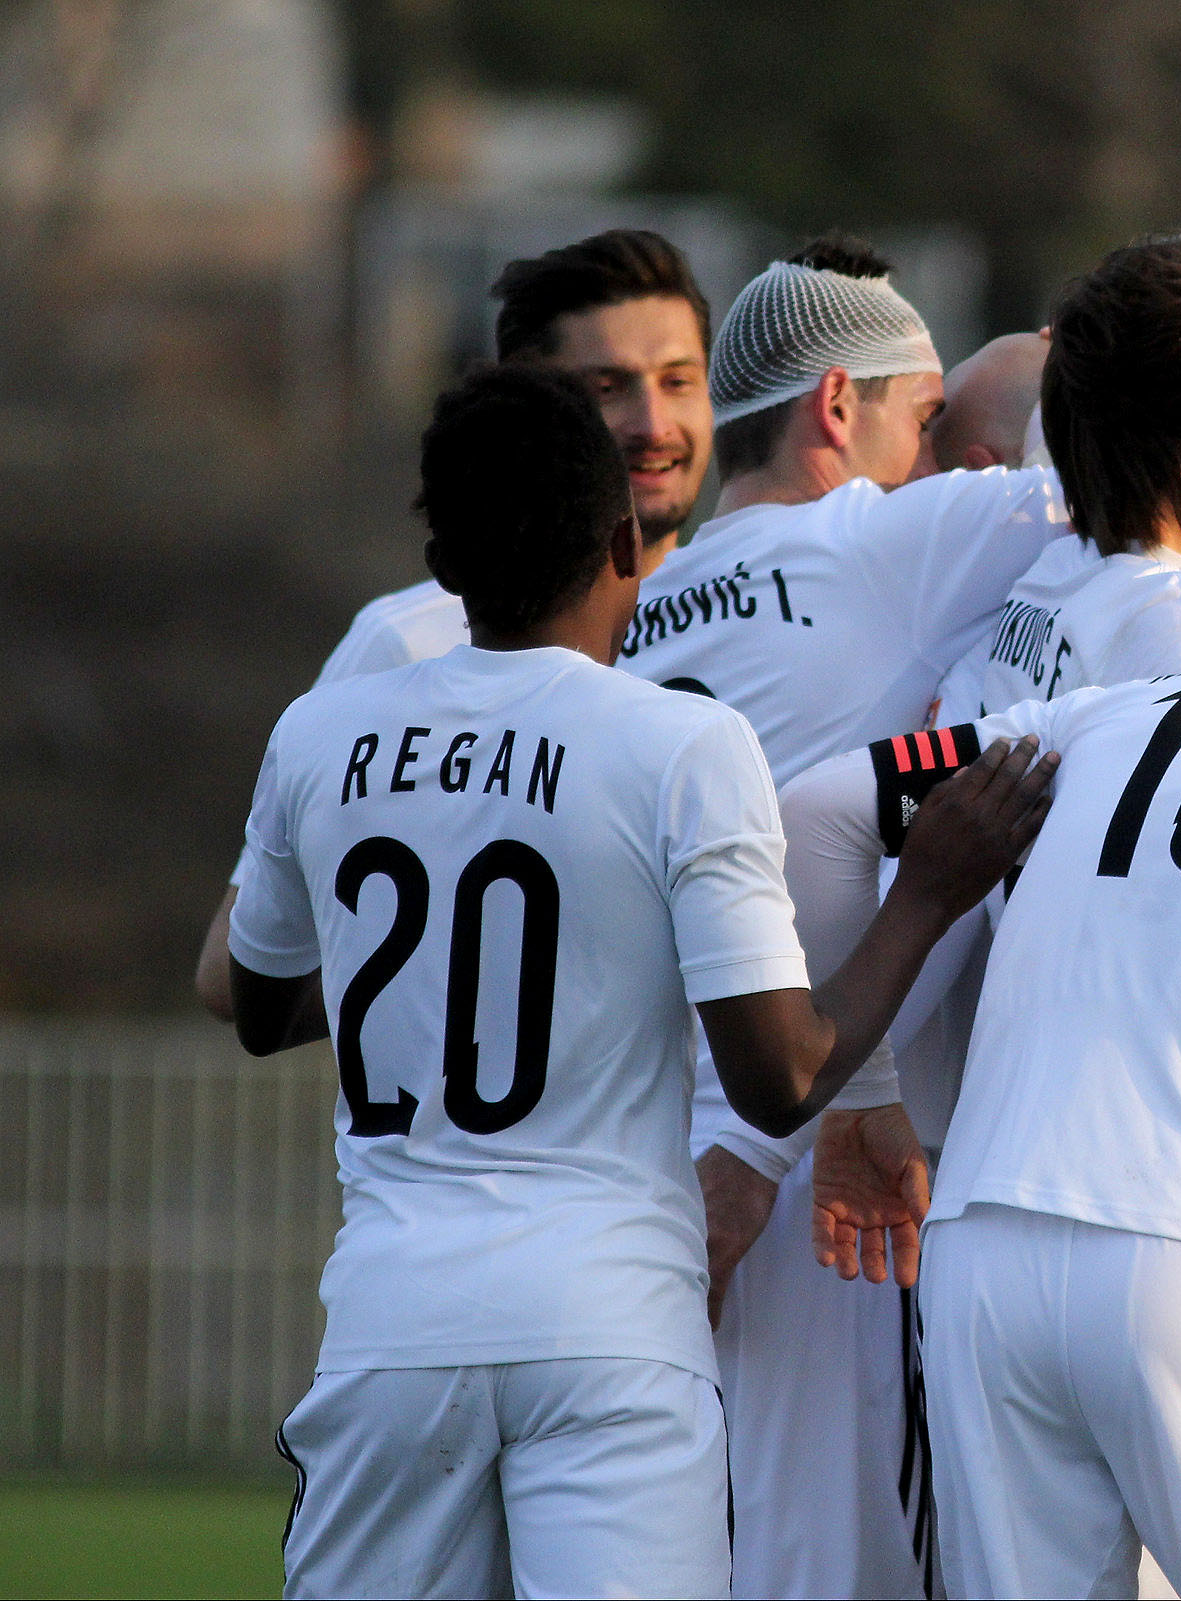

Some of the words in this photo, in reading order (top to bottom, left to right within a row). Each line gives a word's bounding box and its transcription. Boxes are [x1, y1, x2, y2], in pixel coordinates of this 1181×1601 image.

[341, 727, 566, 815] REGAN
[901, 795, 909, 827] adidas
[335, 836, 560, 1137] 20
